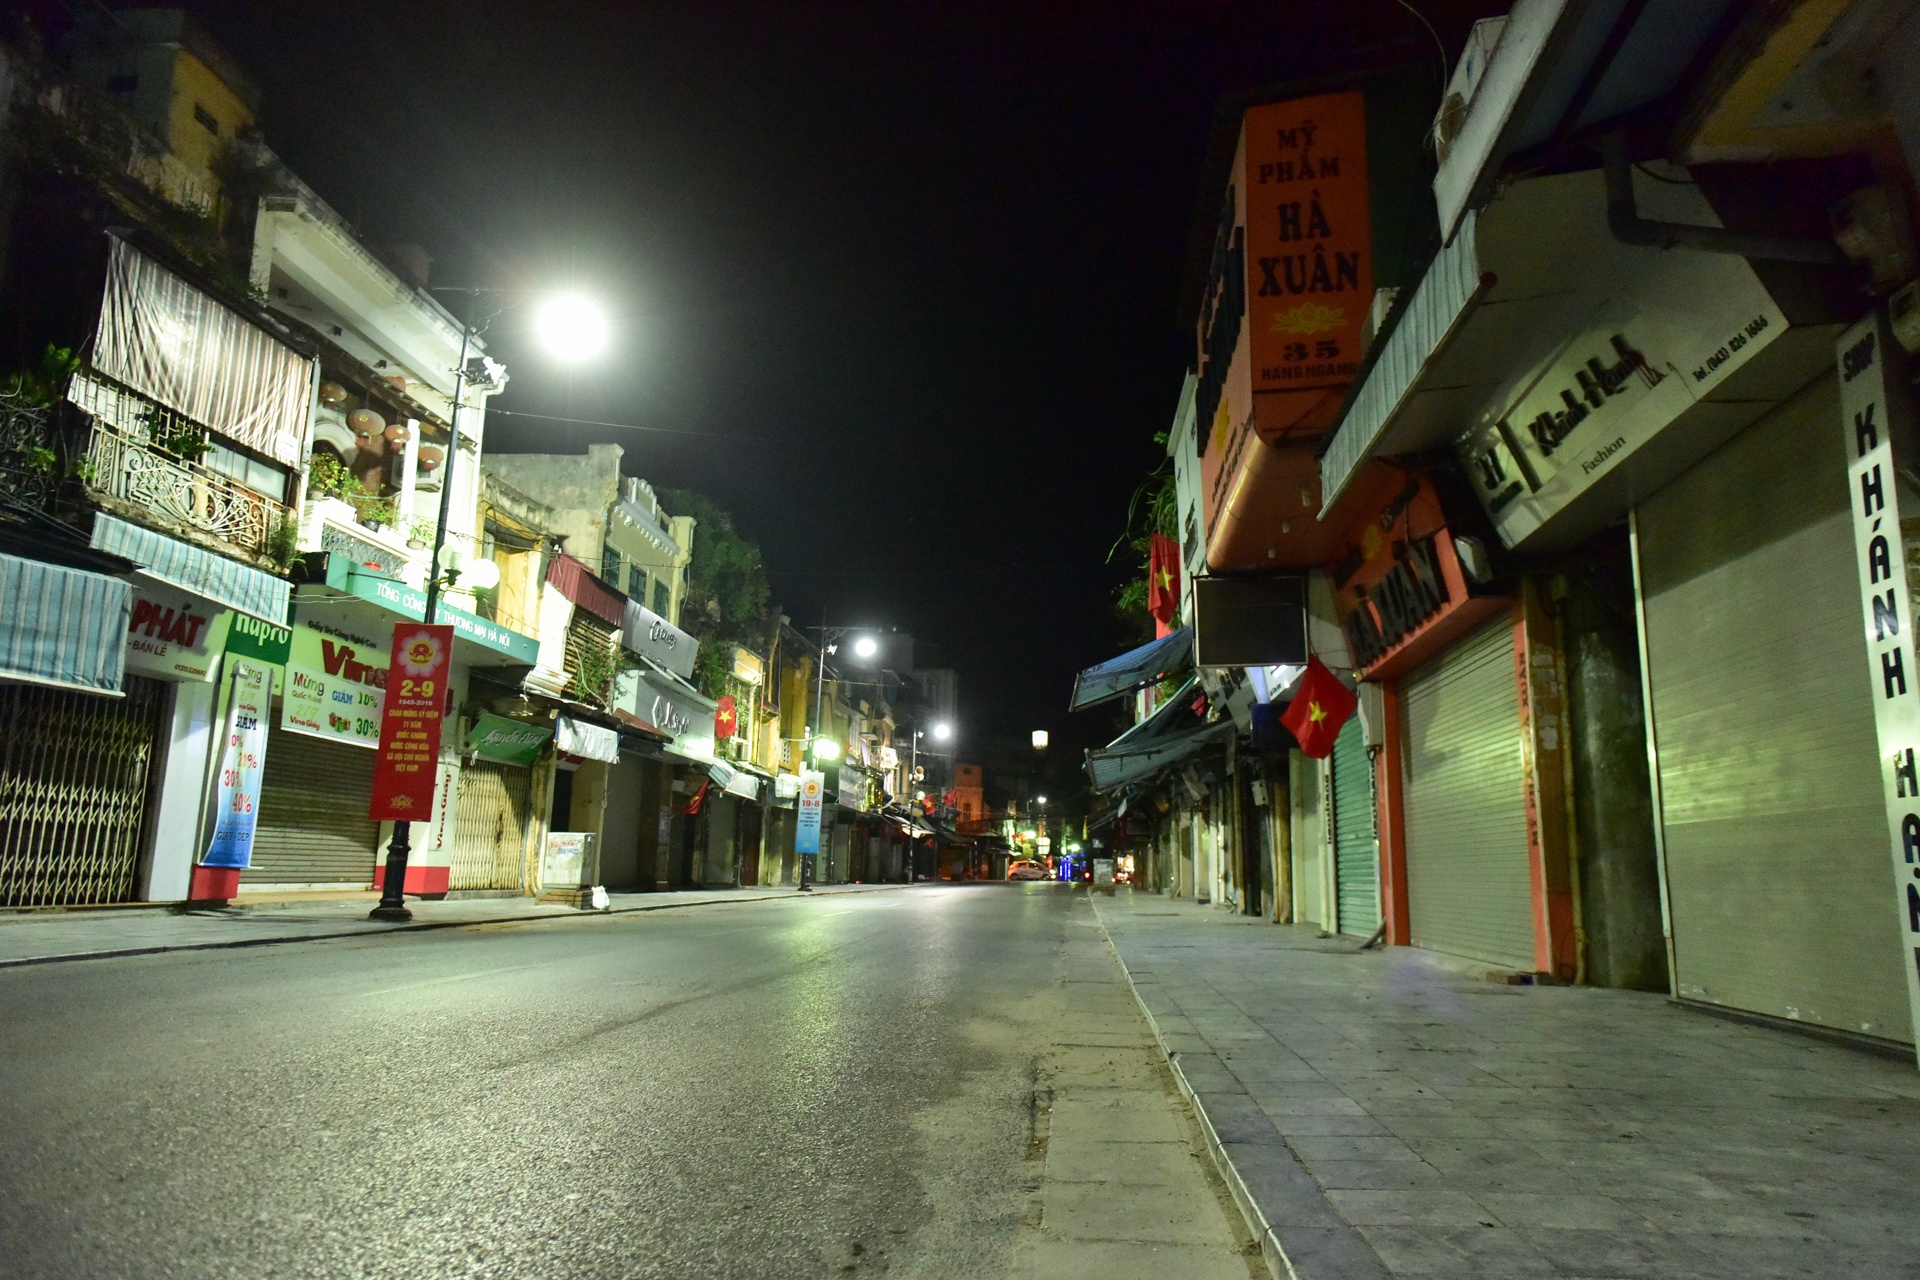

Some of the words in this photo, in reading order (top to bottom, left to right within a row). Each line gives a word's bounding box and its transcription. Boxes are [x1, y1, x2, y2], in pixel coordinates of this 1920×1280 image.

[1258, 148, 1340, 184] PHẨM
[1277, 189, 1332, 242] HÀ
[1258, 243, 1360, 297] XUÂN
[1580, 435, 1627, 476] Fashion
[129, 598, 206, 648] PHÁT
[358, 692, 378, 708] 10%
[400, 679, 434, 697] 2-9
[356, 718, 379, 738] 30%
[802, 799, 820, 808] 19-8
